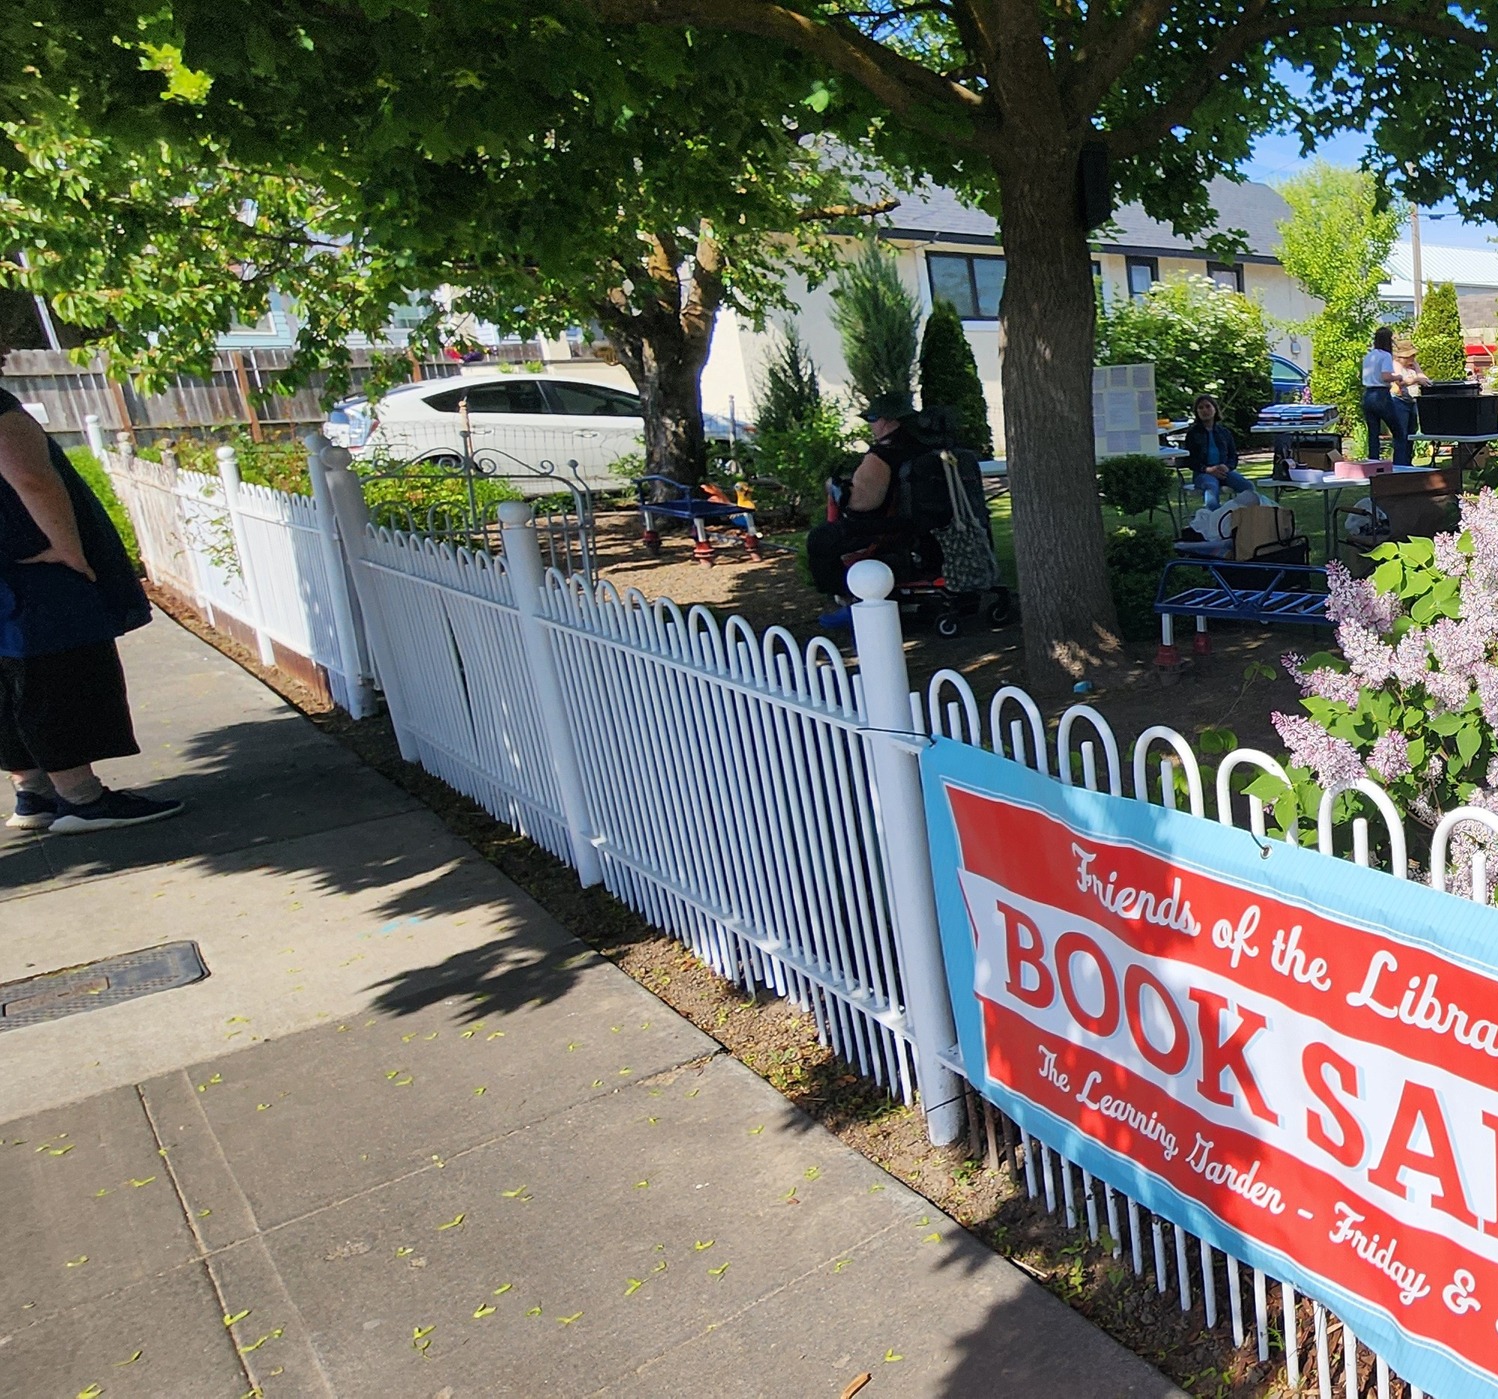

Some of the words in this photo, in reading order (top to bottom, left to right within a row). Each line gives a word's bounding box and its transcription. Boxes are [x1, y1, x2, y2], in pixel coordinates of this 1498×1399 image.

[995, 899, 1282, 1128] BOOK
[1070, 840, 1202, 938] Friends
[1210, 903, 1263, 970] of
[1269, 923, 1334, 993] the
[1037, 1043, 1072, 1094] The
[1074, 1070, 1181, 1161] Learning
[1184, 1130, 1288, 1217] Garden
[1326, 1199, 1433, 1308] Friday
[1440, 1266, 1483, 1317] &
